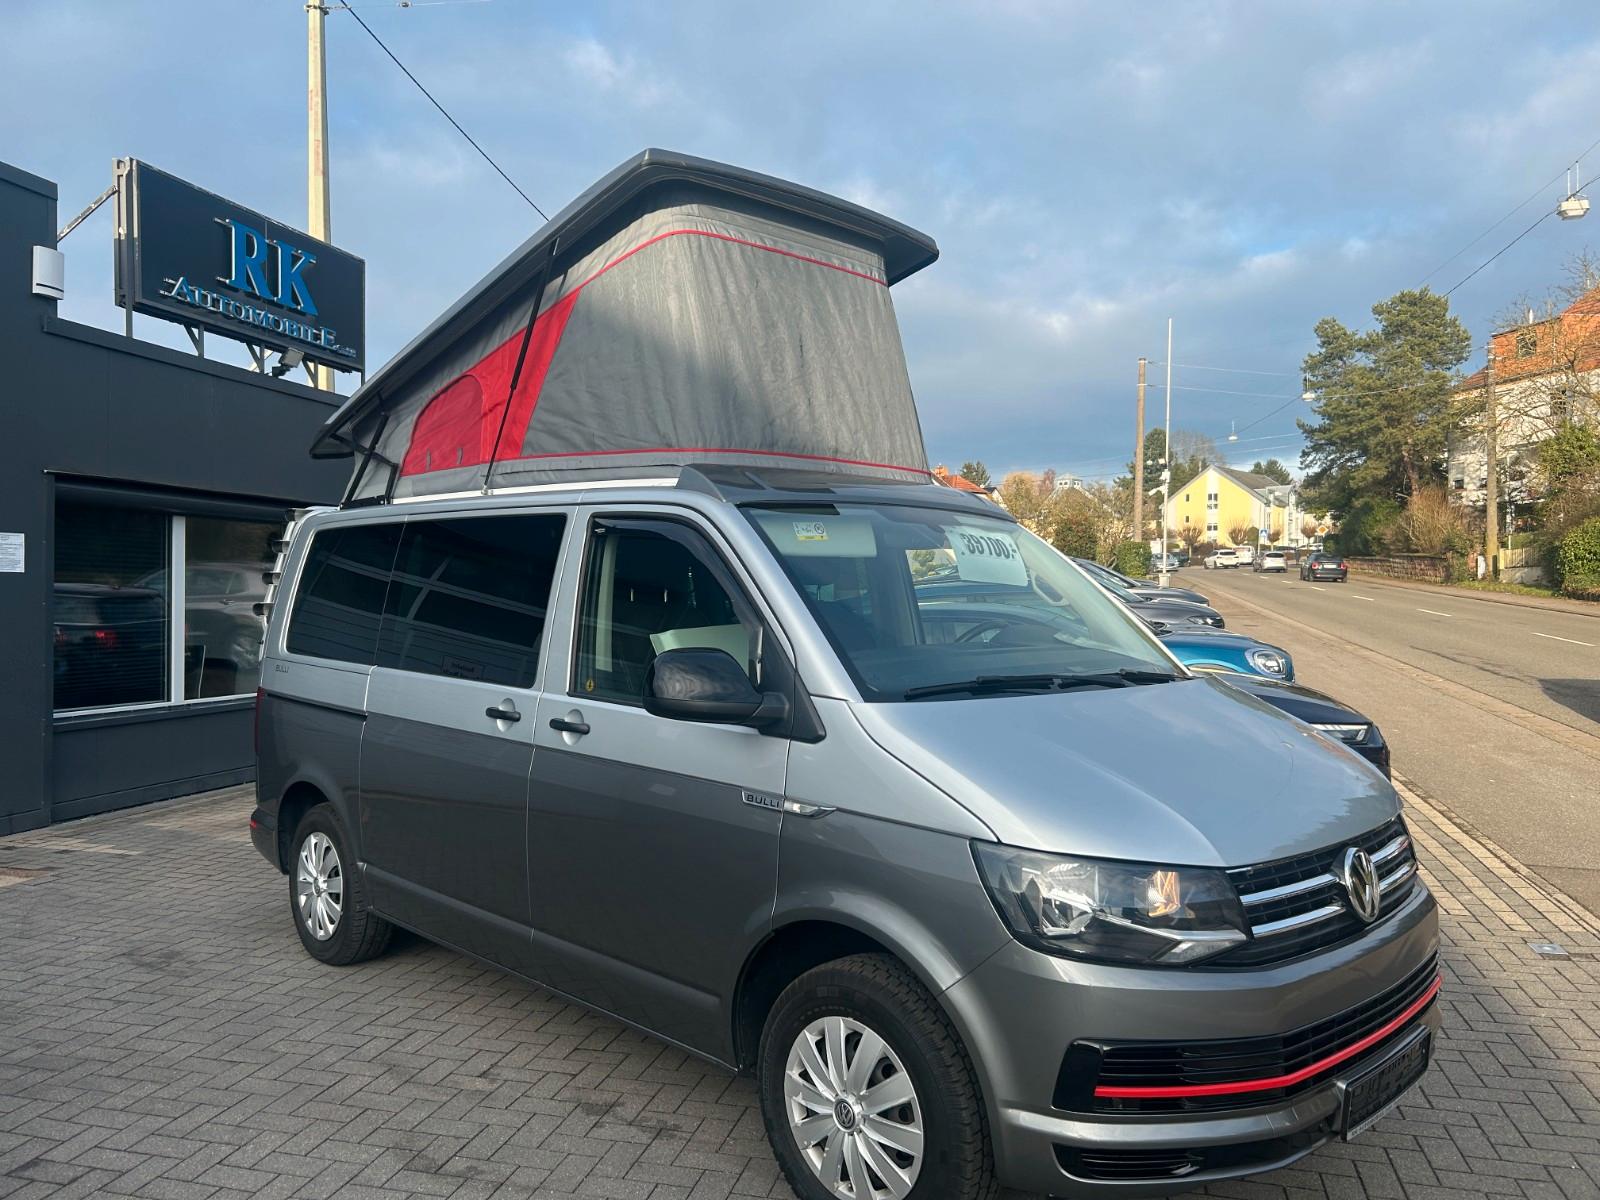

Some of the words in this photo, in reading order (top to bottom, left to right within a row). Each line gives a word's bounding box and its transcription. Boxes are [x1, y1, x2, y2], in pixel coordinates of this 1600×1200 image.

[213, 217, 318, 316] RK
[160, 276, 337, 349] AUTOMOBILE
[746, 794, 780, 809] BULLI
